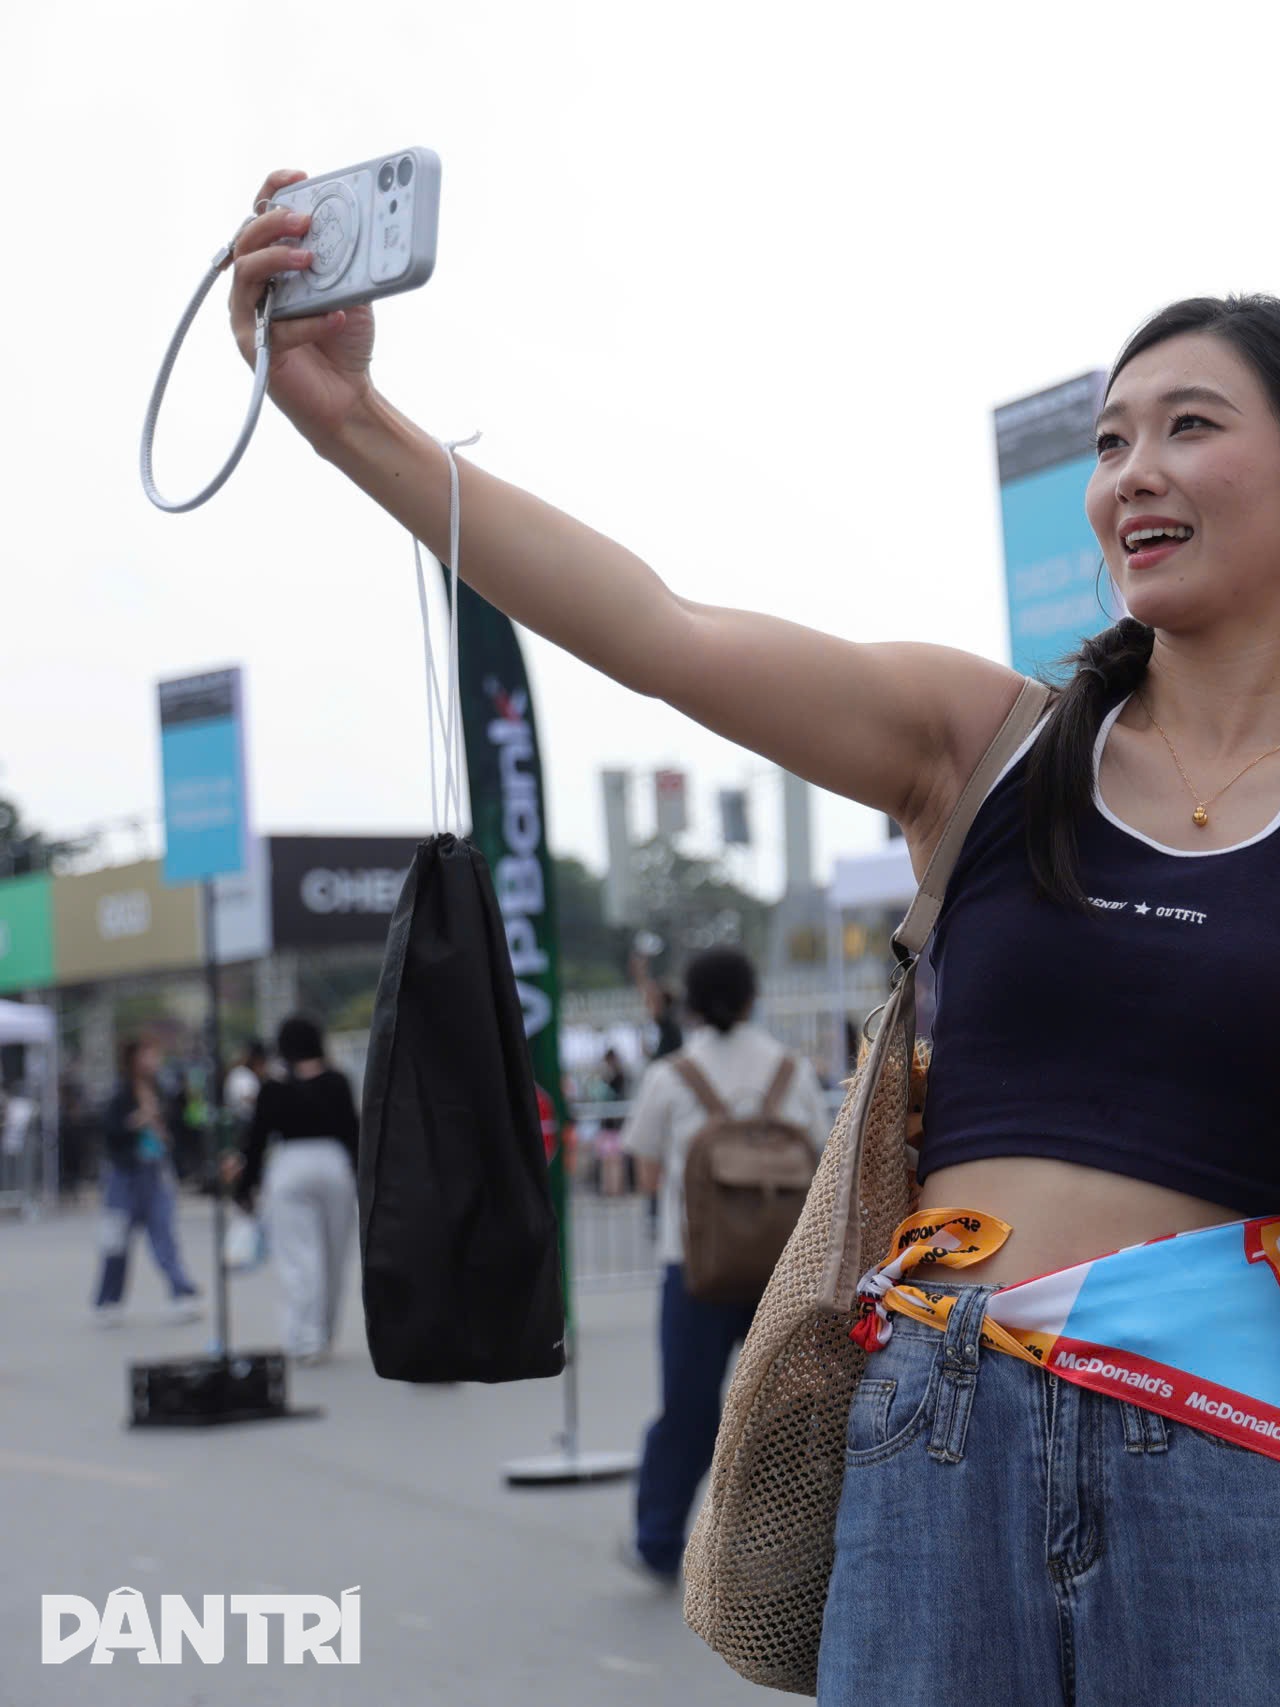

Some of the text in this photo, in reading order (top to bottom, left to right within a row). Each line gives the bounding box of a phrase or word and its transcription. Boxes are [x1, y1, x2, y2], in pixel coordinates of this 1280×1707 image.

[1086, 896, 1207, 924] ENDY OUTFIT
[1054, 1351, 1174, 1399] McDonald's
